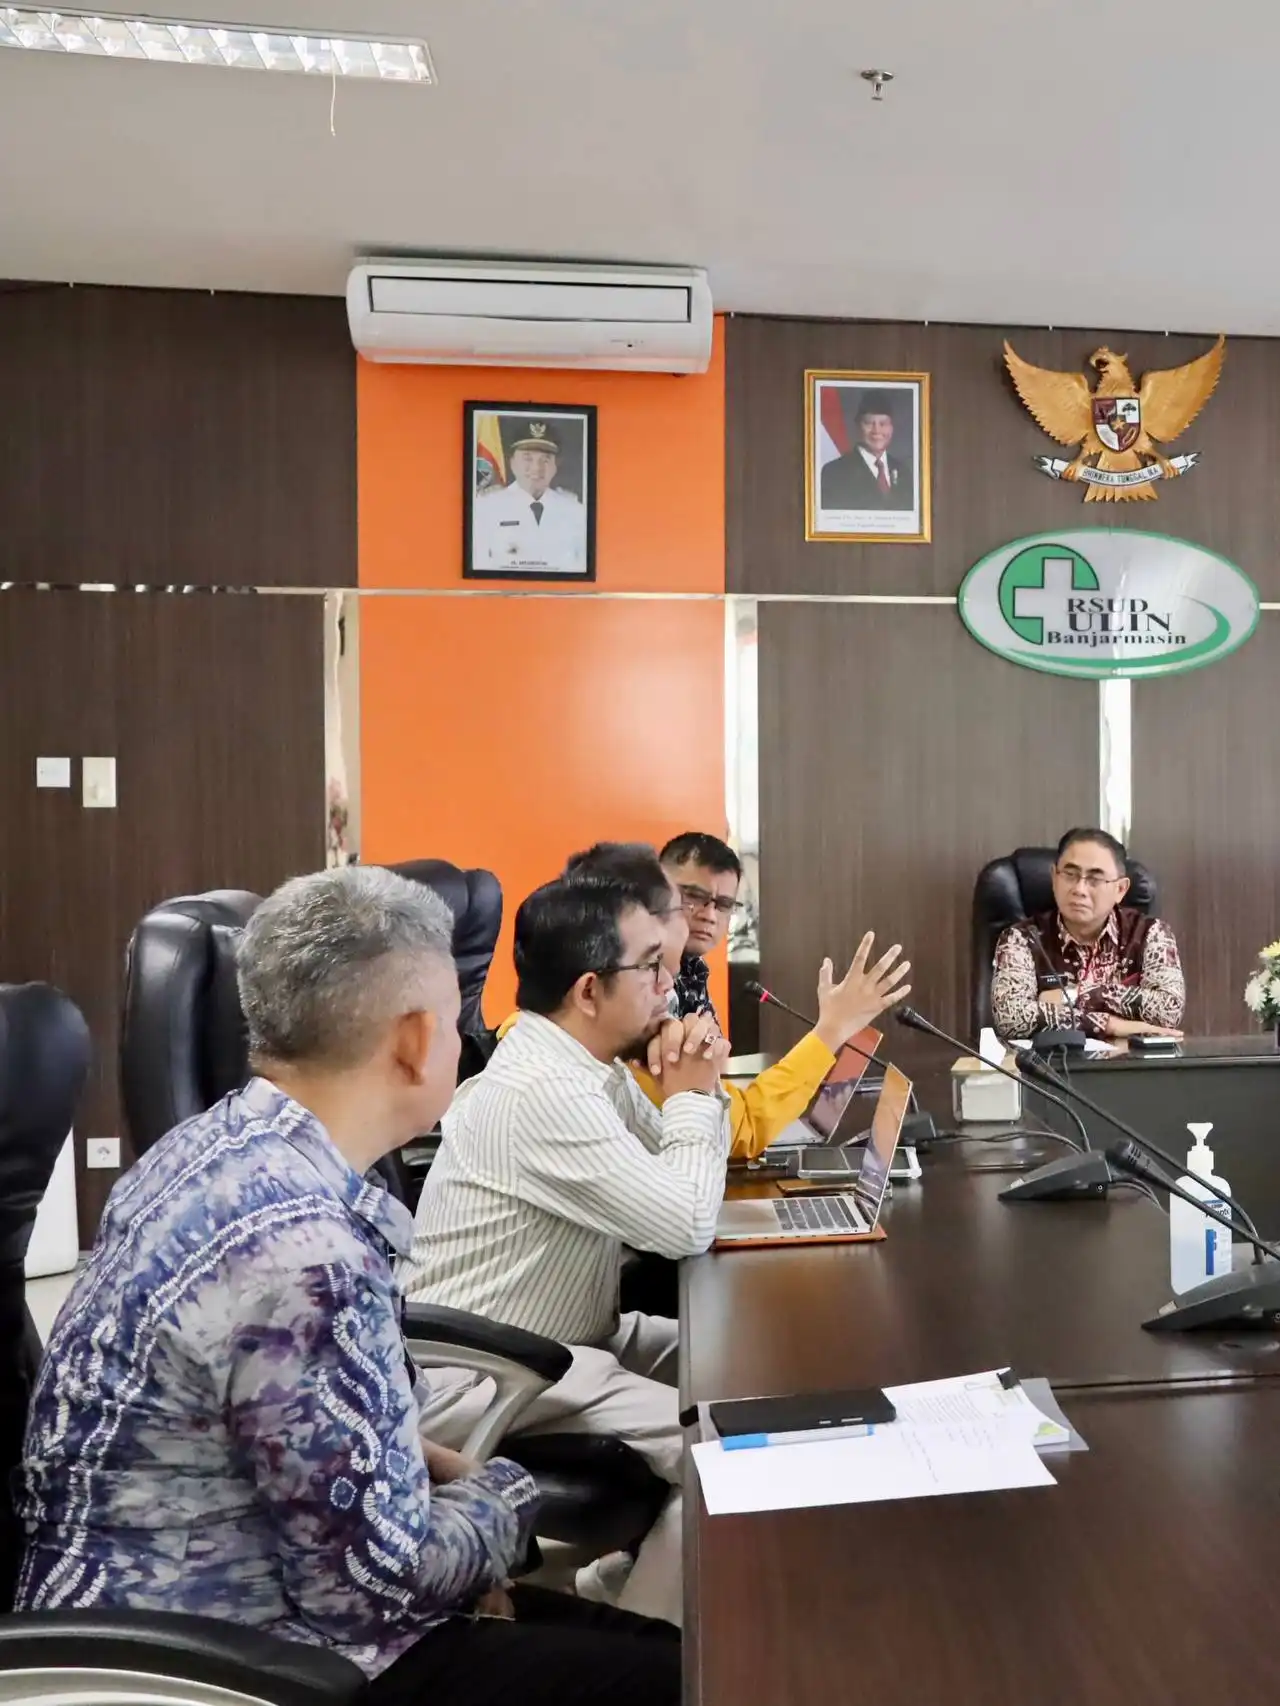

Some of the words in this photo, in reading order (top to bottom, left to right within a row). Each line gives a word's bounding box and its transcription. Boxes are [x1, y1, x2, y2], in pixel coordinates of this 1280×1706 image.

[1066, 597, 1149, 613] RSUD
[1068, 613, 1171, 632] ULIN
[1047, 631, 1187, 647] Banjarmasin
